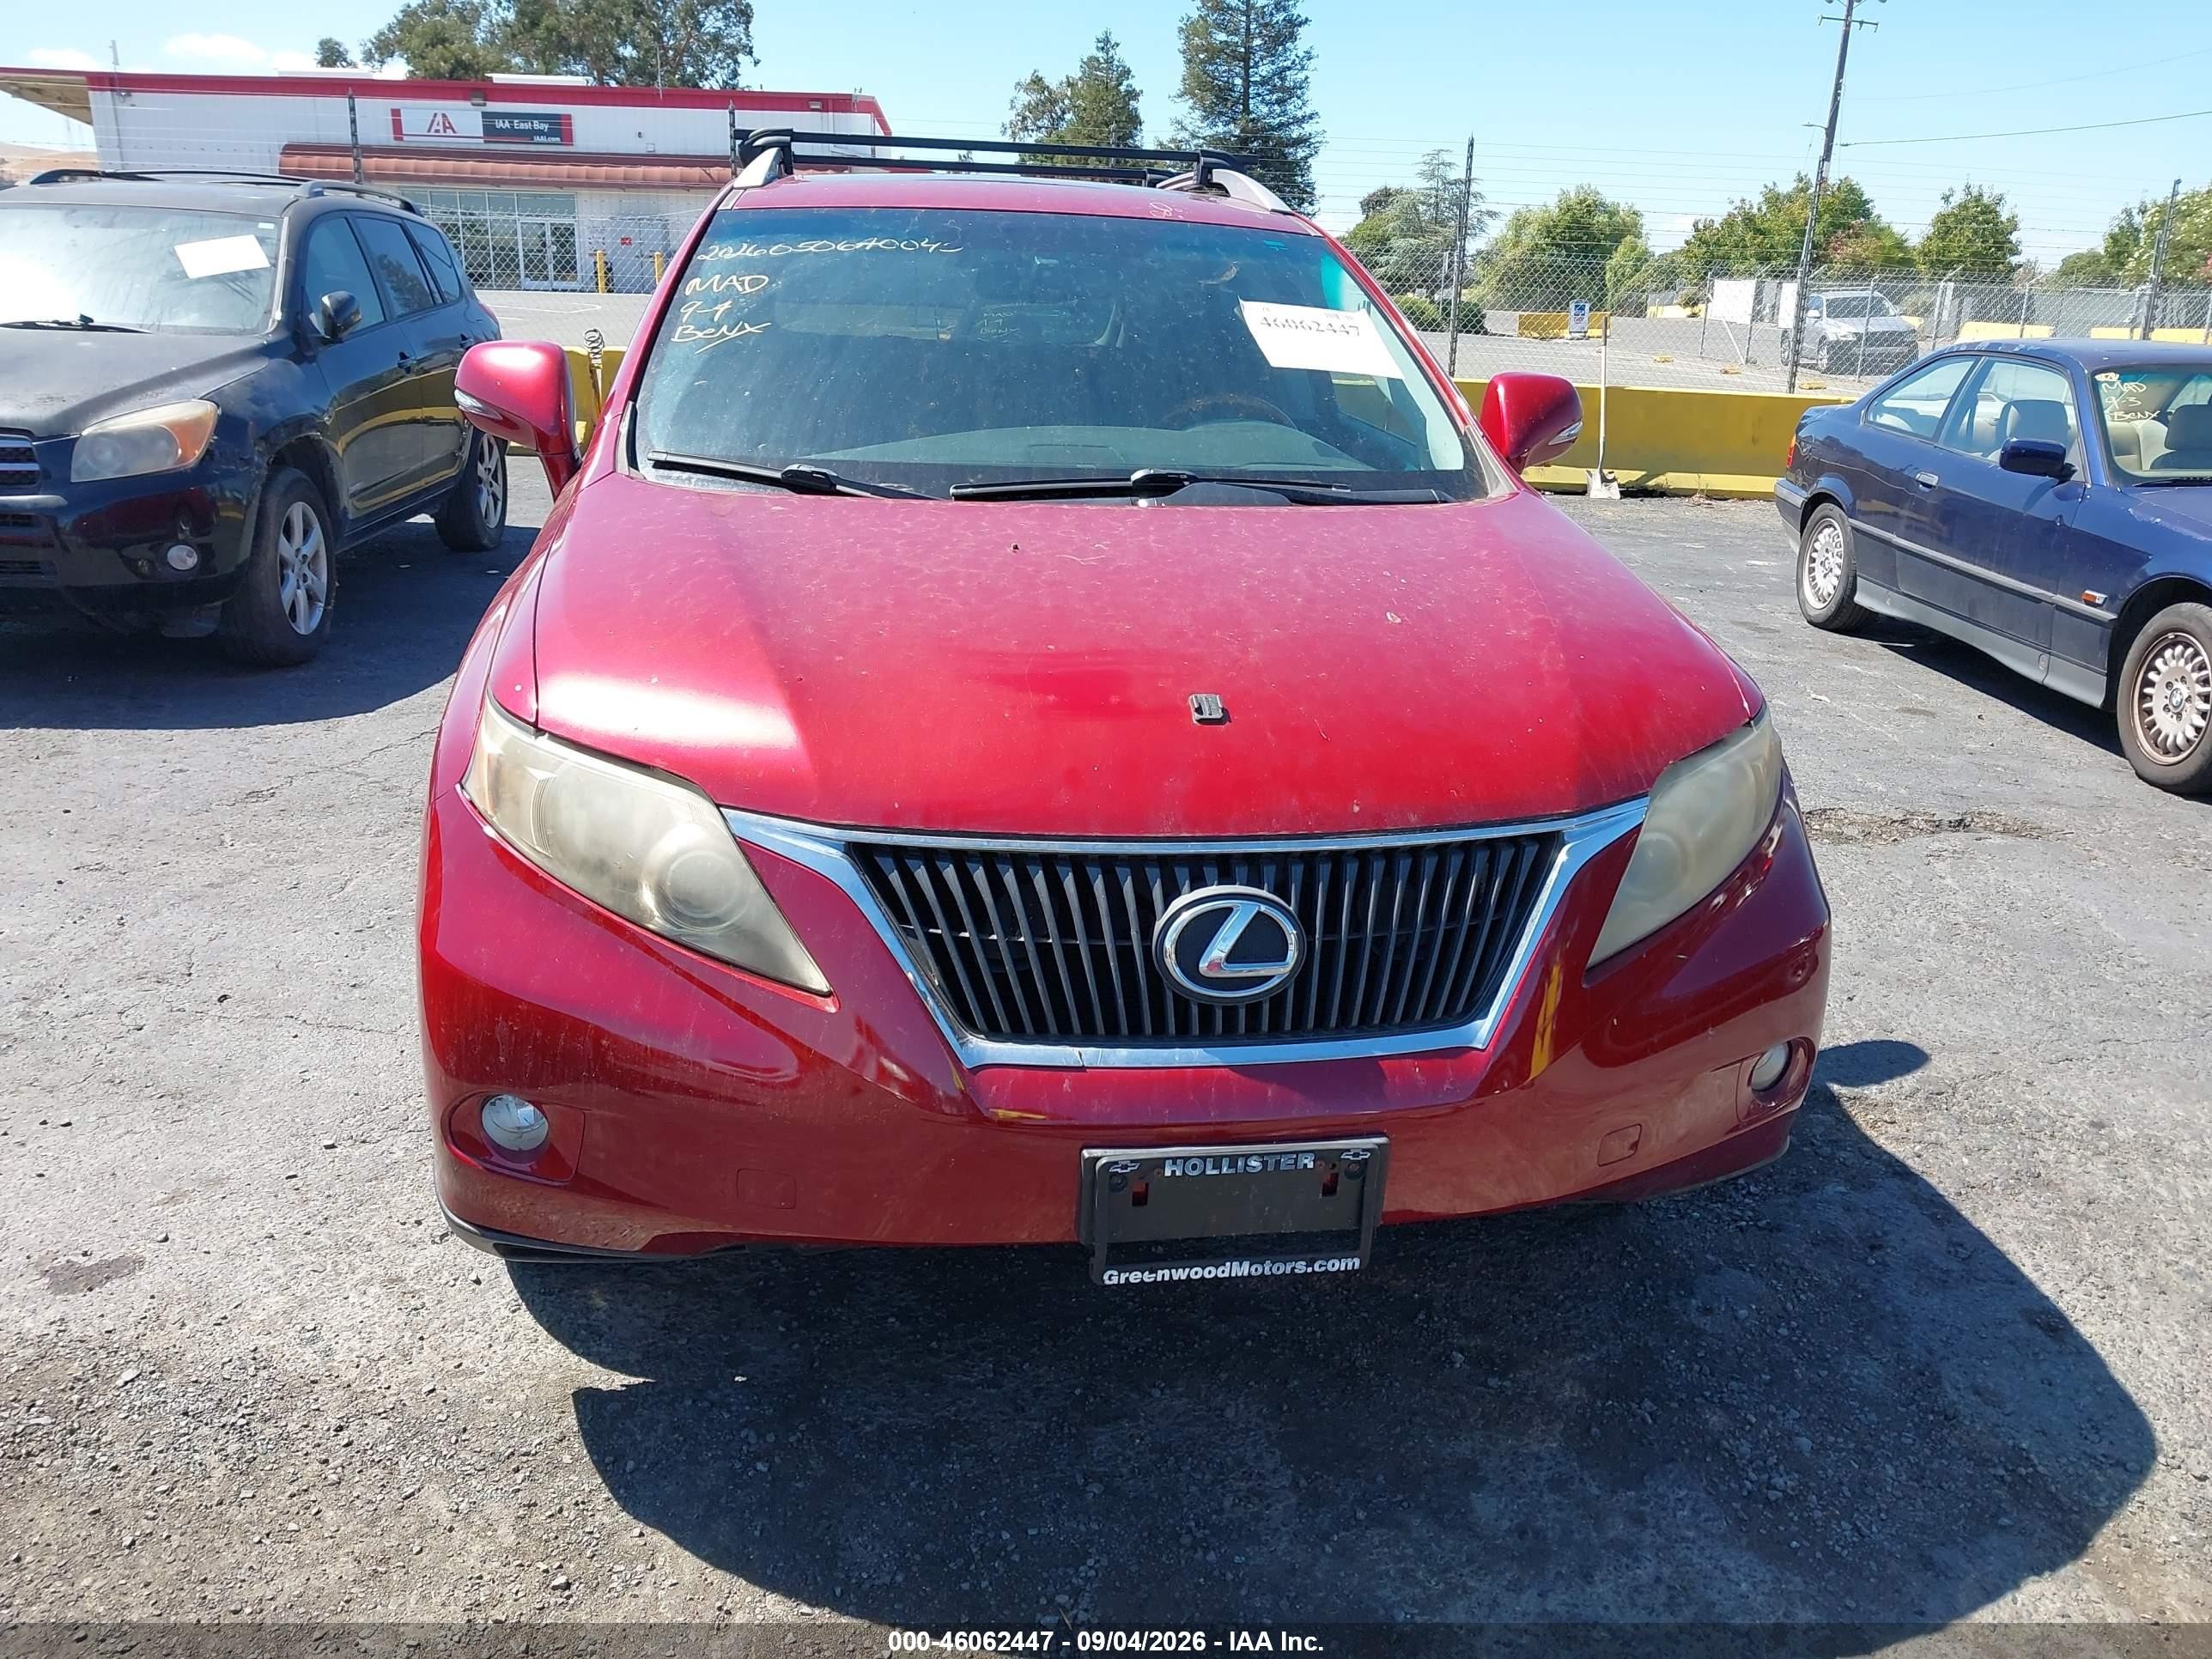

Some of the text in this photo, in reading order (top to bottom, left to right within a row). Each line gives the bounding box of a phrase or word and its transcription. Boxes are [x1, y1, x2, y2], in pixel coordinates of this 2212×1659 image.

[495, 119, 550, 132] IAA East Bay
[684, 274, 769, 296] MAD
[2101, 381, 2147, 393] MAD
[2105, 396, 2142, 410] 9-3
[1164, 1152, 1316, 1177] HOLLISTER
[1102, 1256, 1361, 1285] GreenwoodMotors.com
